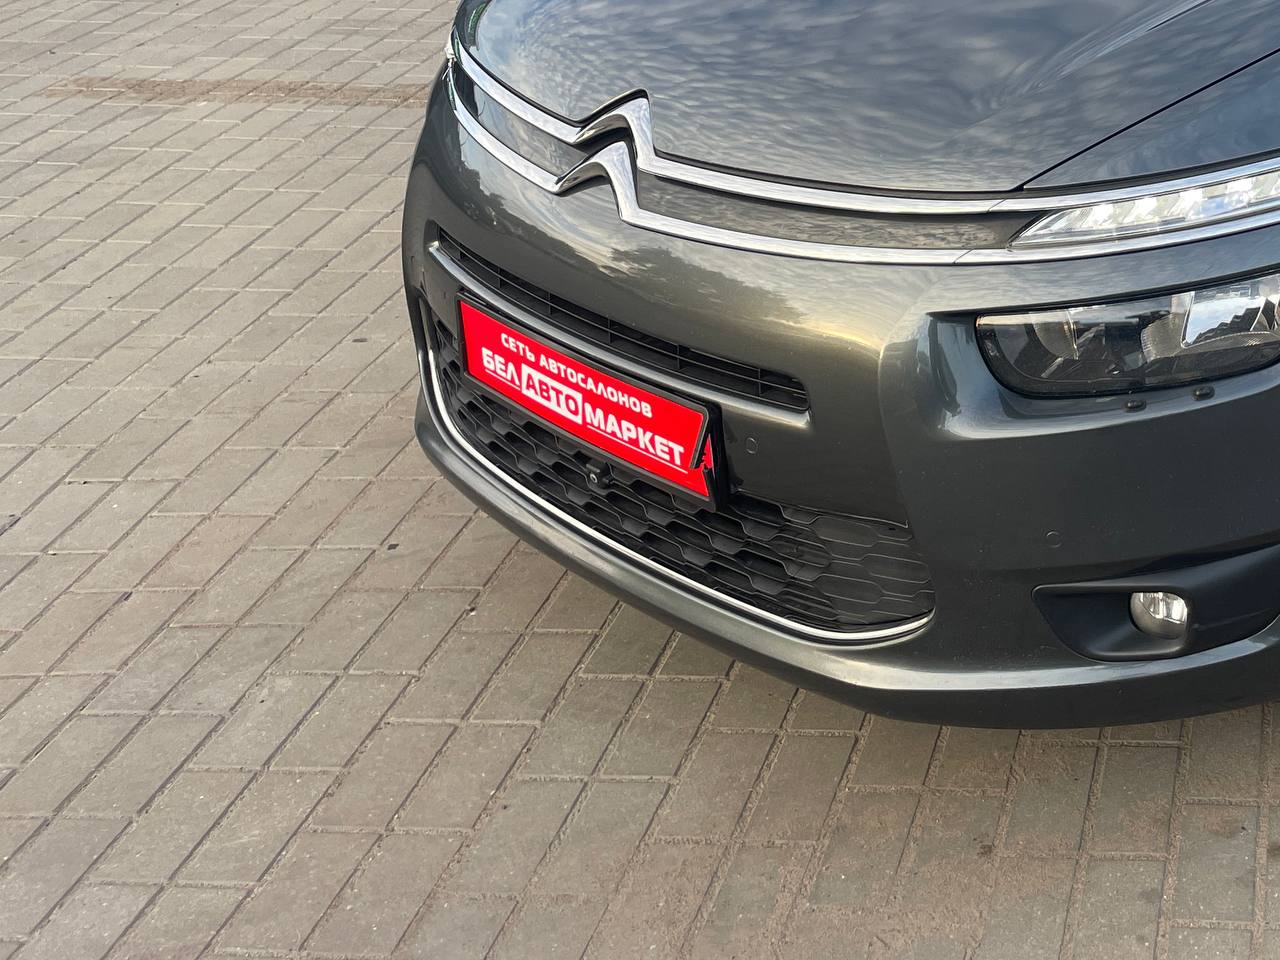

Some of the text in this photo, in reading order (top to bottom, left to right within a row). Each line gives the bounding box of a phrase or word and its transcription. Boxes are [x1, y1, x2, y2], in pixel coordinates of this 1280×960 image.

[481, 347, 685, 466] БЕЛ АВТО МАРКЕТ
[501, 332, 653, 418] СЕТЬ АВТОСАЛОНОВ
